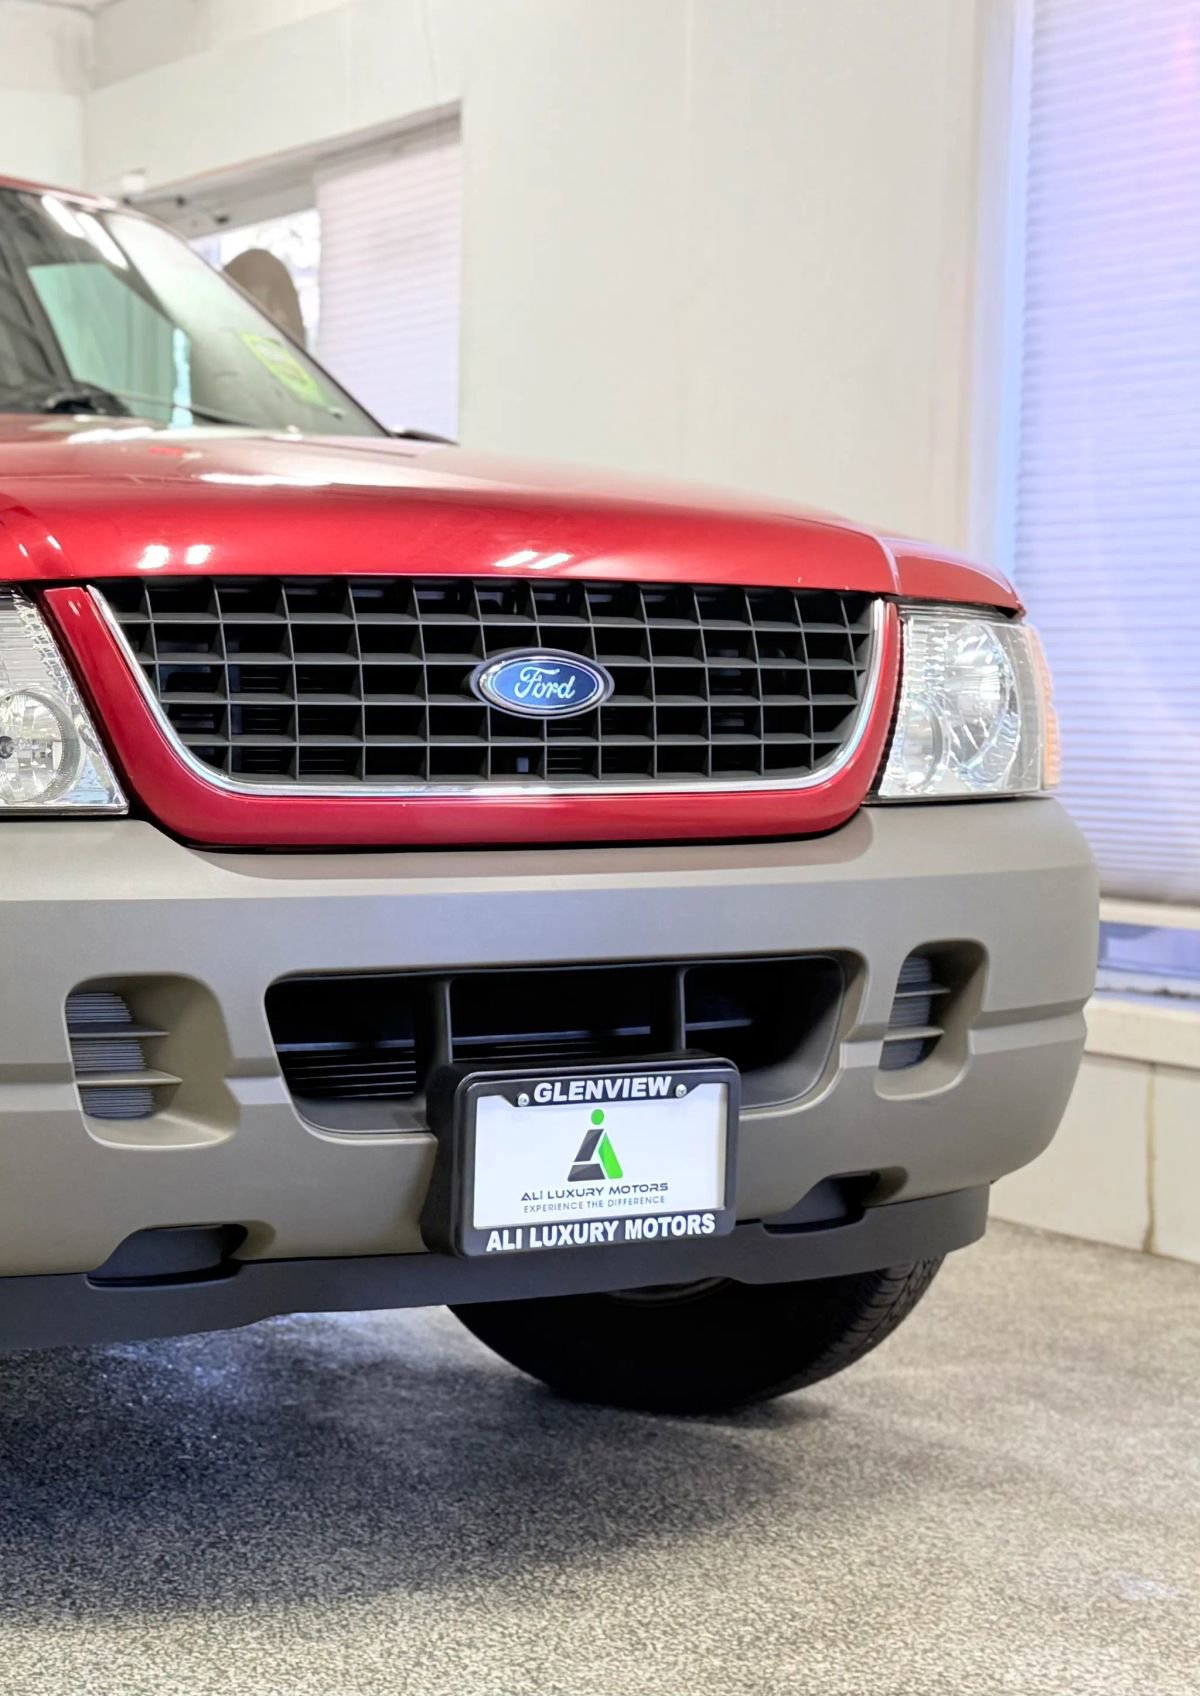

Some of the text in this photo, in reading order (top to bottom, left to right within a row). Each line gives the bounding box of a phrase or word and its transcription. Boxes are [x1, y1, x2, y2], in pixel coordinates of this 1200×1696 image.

[514, 666, 575, 699] Ford
[533, 1075, 672, 1103] GLENVIEW
[520, 1182, 669, 1201] ALI LUXURY MOTORS
[523, 1195, 665, 1213] EXPERIENCE THE DIFFERENCE
[486, 1213, 716, 1252] ALI LUXURY MOTORS
